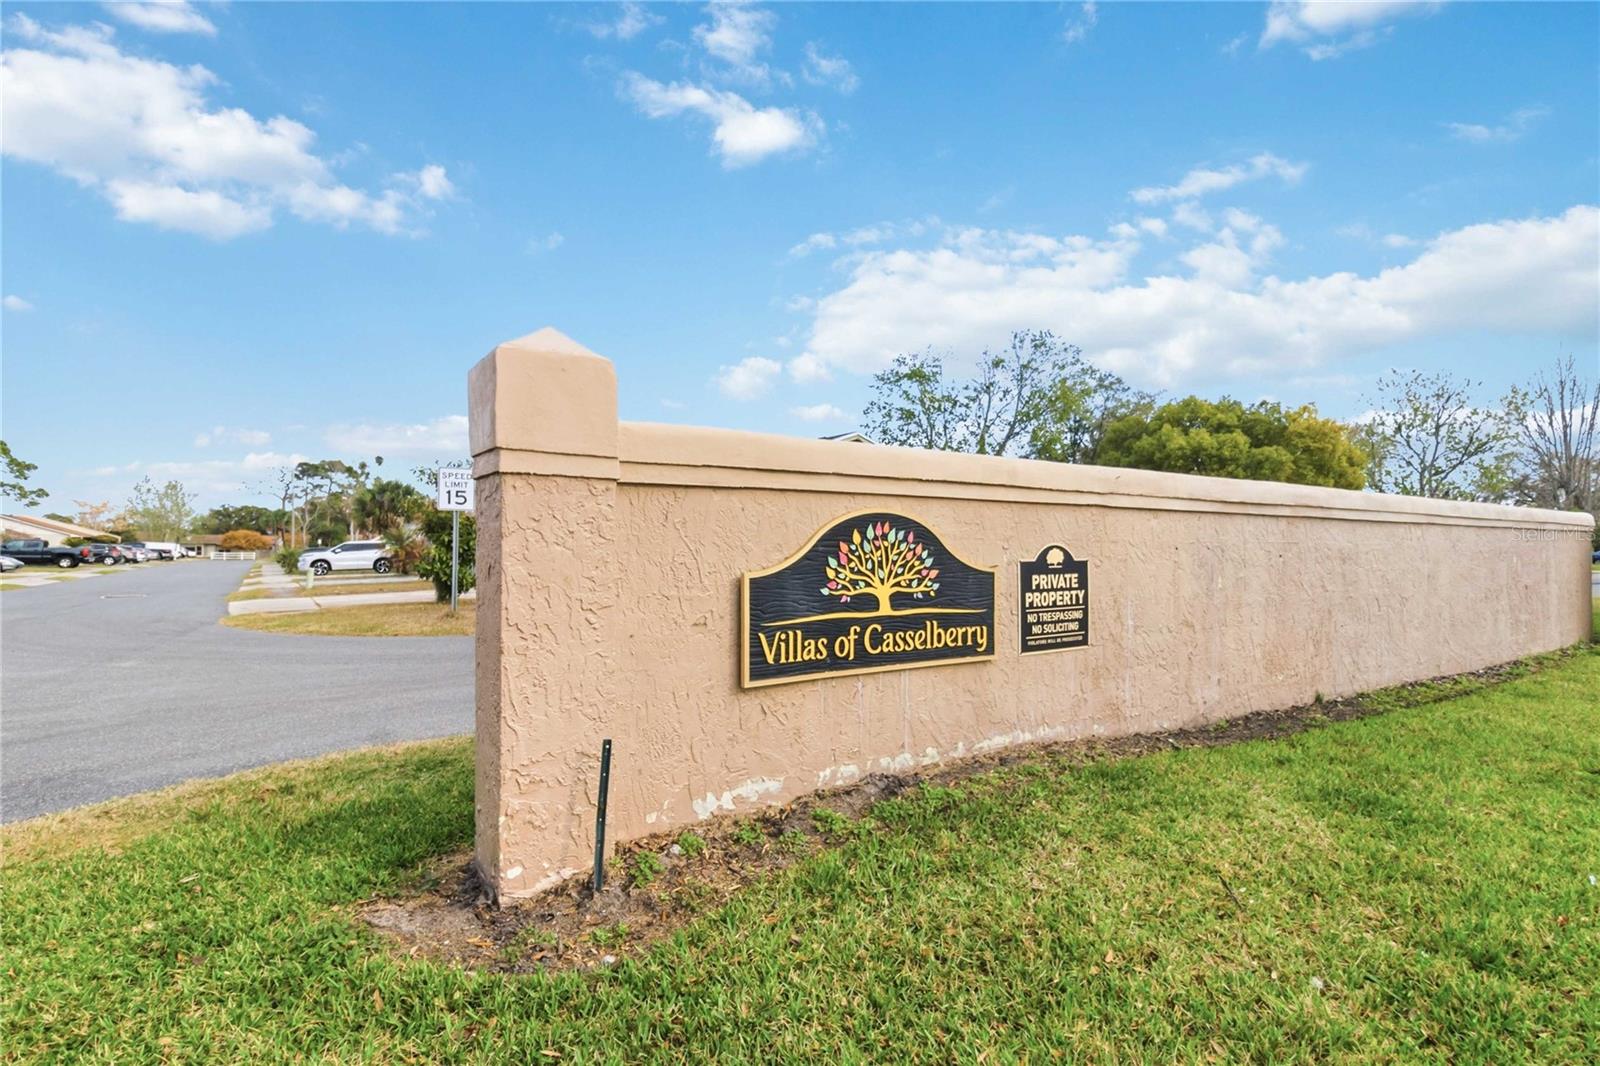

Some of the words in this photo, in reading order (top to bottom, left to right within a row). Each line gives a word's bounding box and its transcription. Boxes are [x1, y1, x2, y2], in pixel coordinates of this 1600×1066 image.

[446, 490, 467, 505] 15
[1031, 574, 1079, 590] PRIVATE
[1025, 590, 1085, 607] PROPERTY
[1027, 613, 1038, 623] NO
[1039, 610, 1083, 622] TRESPASSING
[1032, 624, 1042, 634] NO
[1043, 621, 1079, 633] SOLICITING
[758, 630, 827, 664] Villas
[834, 625, 860, 660] of
[863, 620, 988, 654] Casselberry
